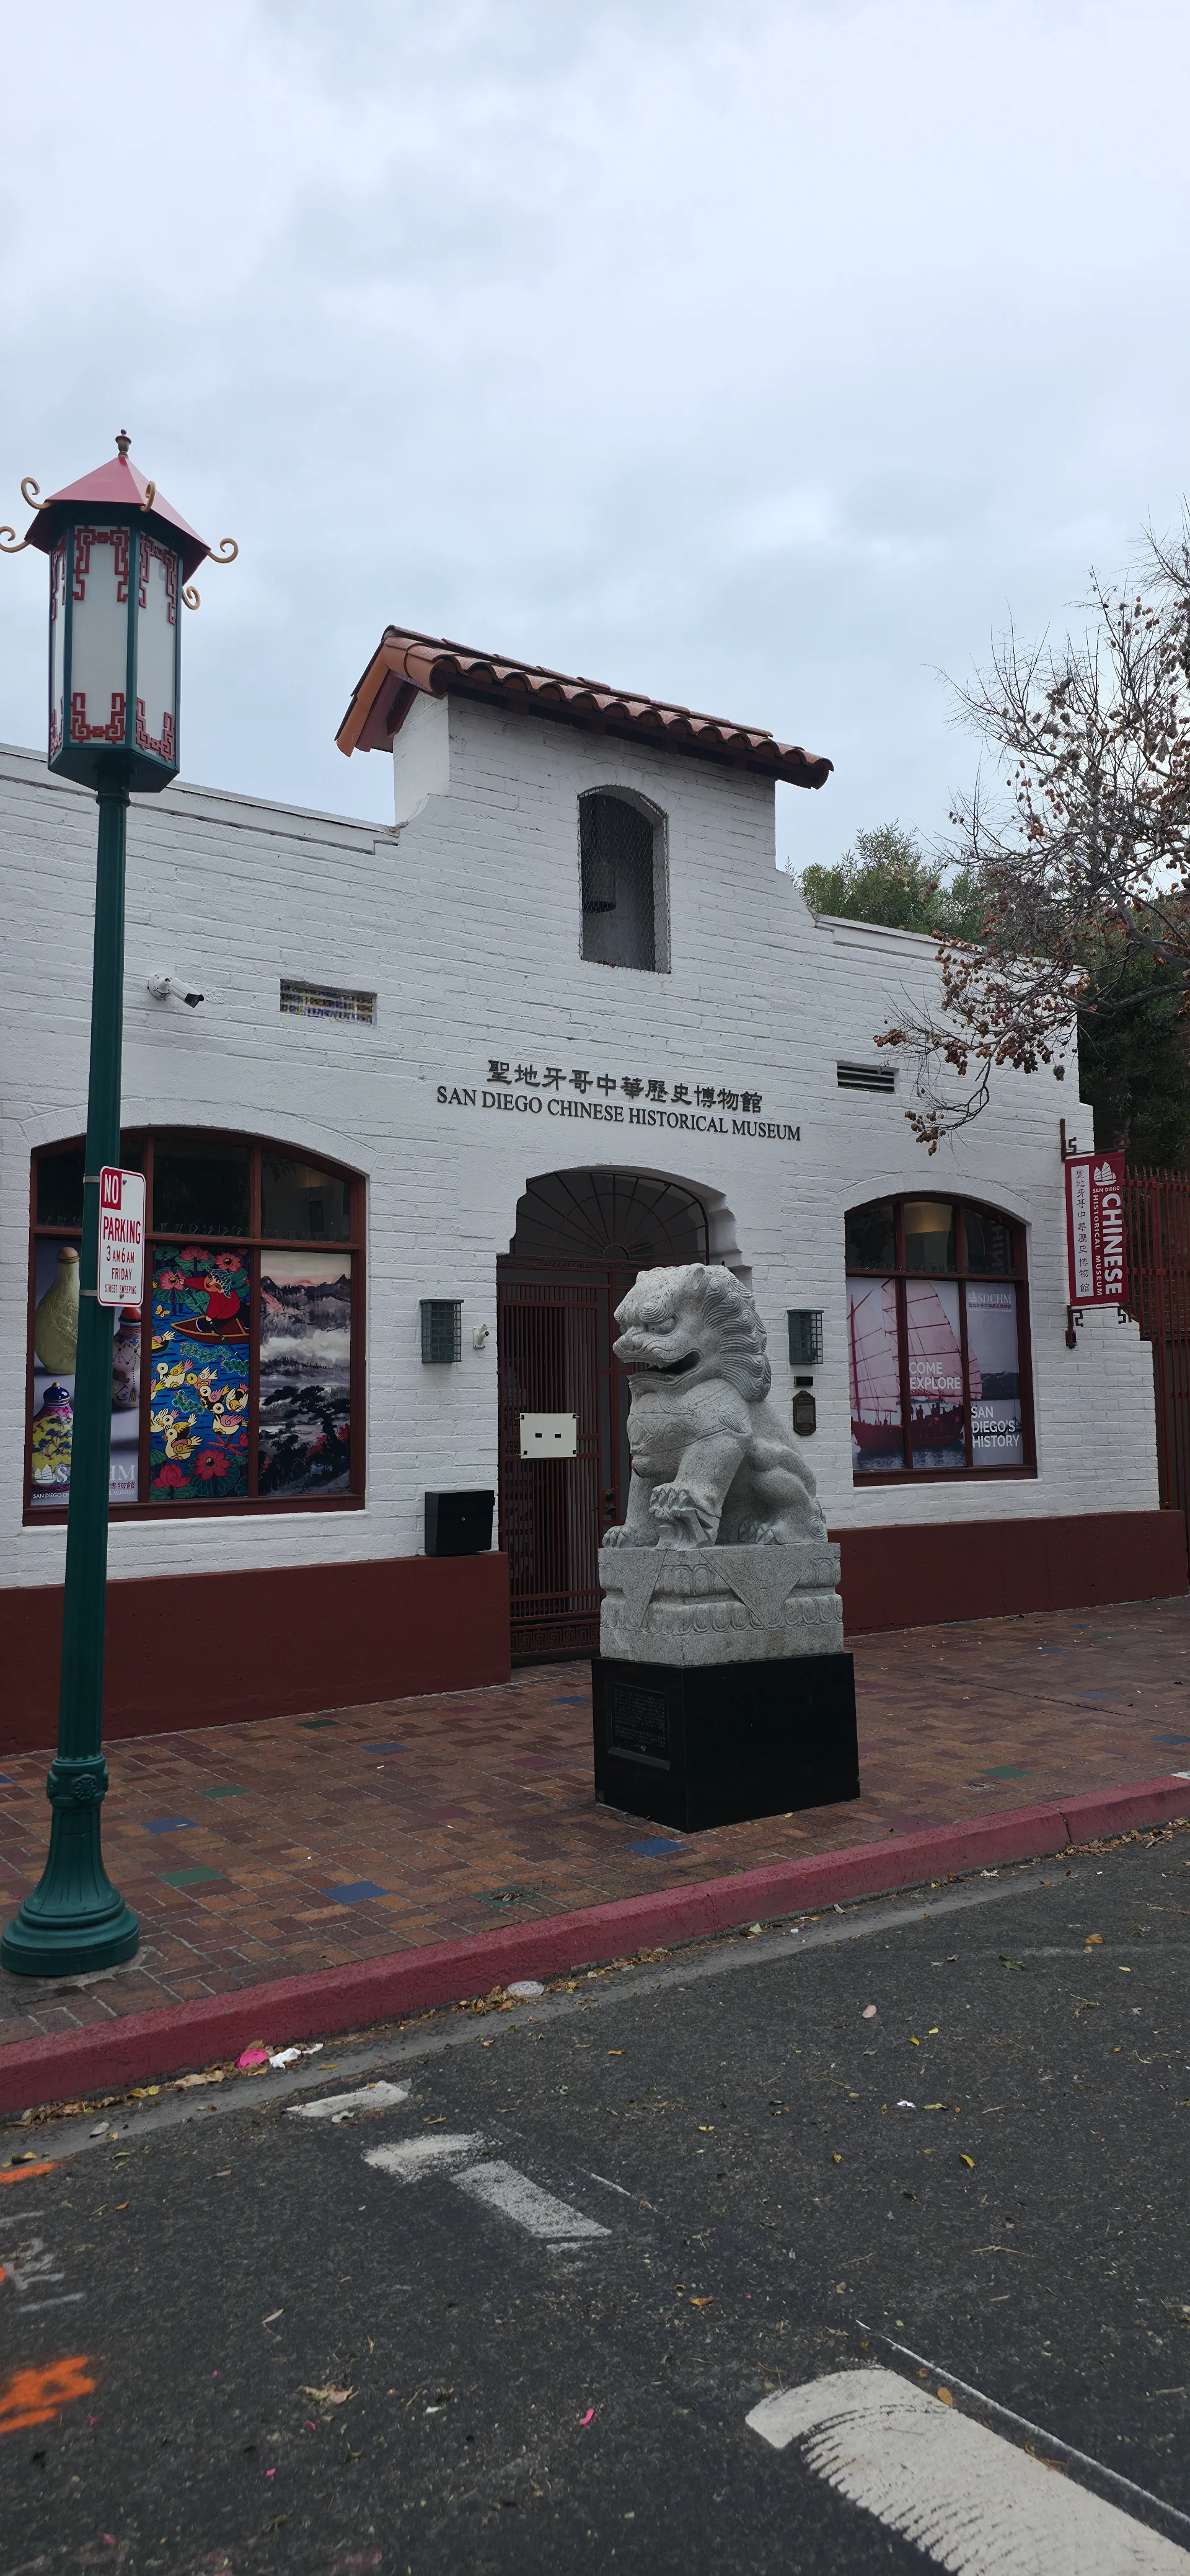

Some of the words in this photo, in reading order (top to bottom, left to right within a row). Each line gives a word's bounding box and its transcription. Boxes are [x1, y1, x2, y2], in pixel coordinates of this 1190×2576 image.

[487, 1060, 763, 1114] 聖地牙哥中華歷史博物館
[437, 1086, 477, 1106] SAN
[482, 1091, 542, 1114] DIEGO
[547, 1099, 625, 1122] CHINESE
[628, 1107, 729, 1133] HISTORICAL
[732, 1119, 801, 1141] MUSEUM
[104, 1174, 119, 1204] NO
[1093, 1195, 1101, 1250] HISTORICAL
[103, 1216, 141, 1245] PARKING
[1076, 1170, 1090, 1293] 聖地牙哥中華歷史博物館
[1102, 1193, 1122, 1295] CHINESE
[112, 1267, 133, 1280] FRIDAY
[105, 1283, 117, 1293] STREET
[119, 1285, 137, 1294] SWEEPING
[977, 1293, 1011, 1304] SDCHM
[909, 1361, 943, 1374] COME
[910, 1377, 961, 1389] EXPLORE
[971, 1406, 994, 1418] SAN
[972, 1420, 1015, 1433] DIEGO'S
[972, 1435, 1020, 1448] HISTORY
